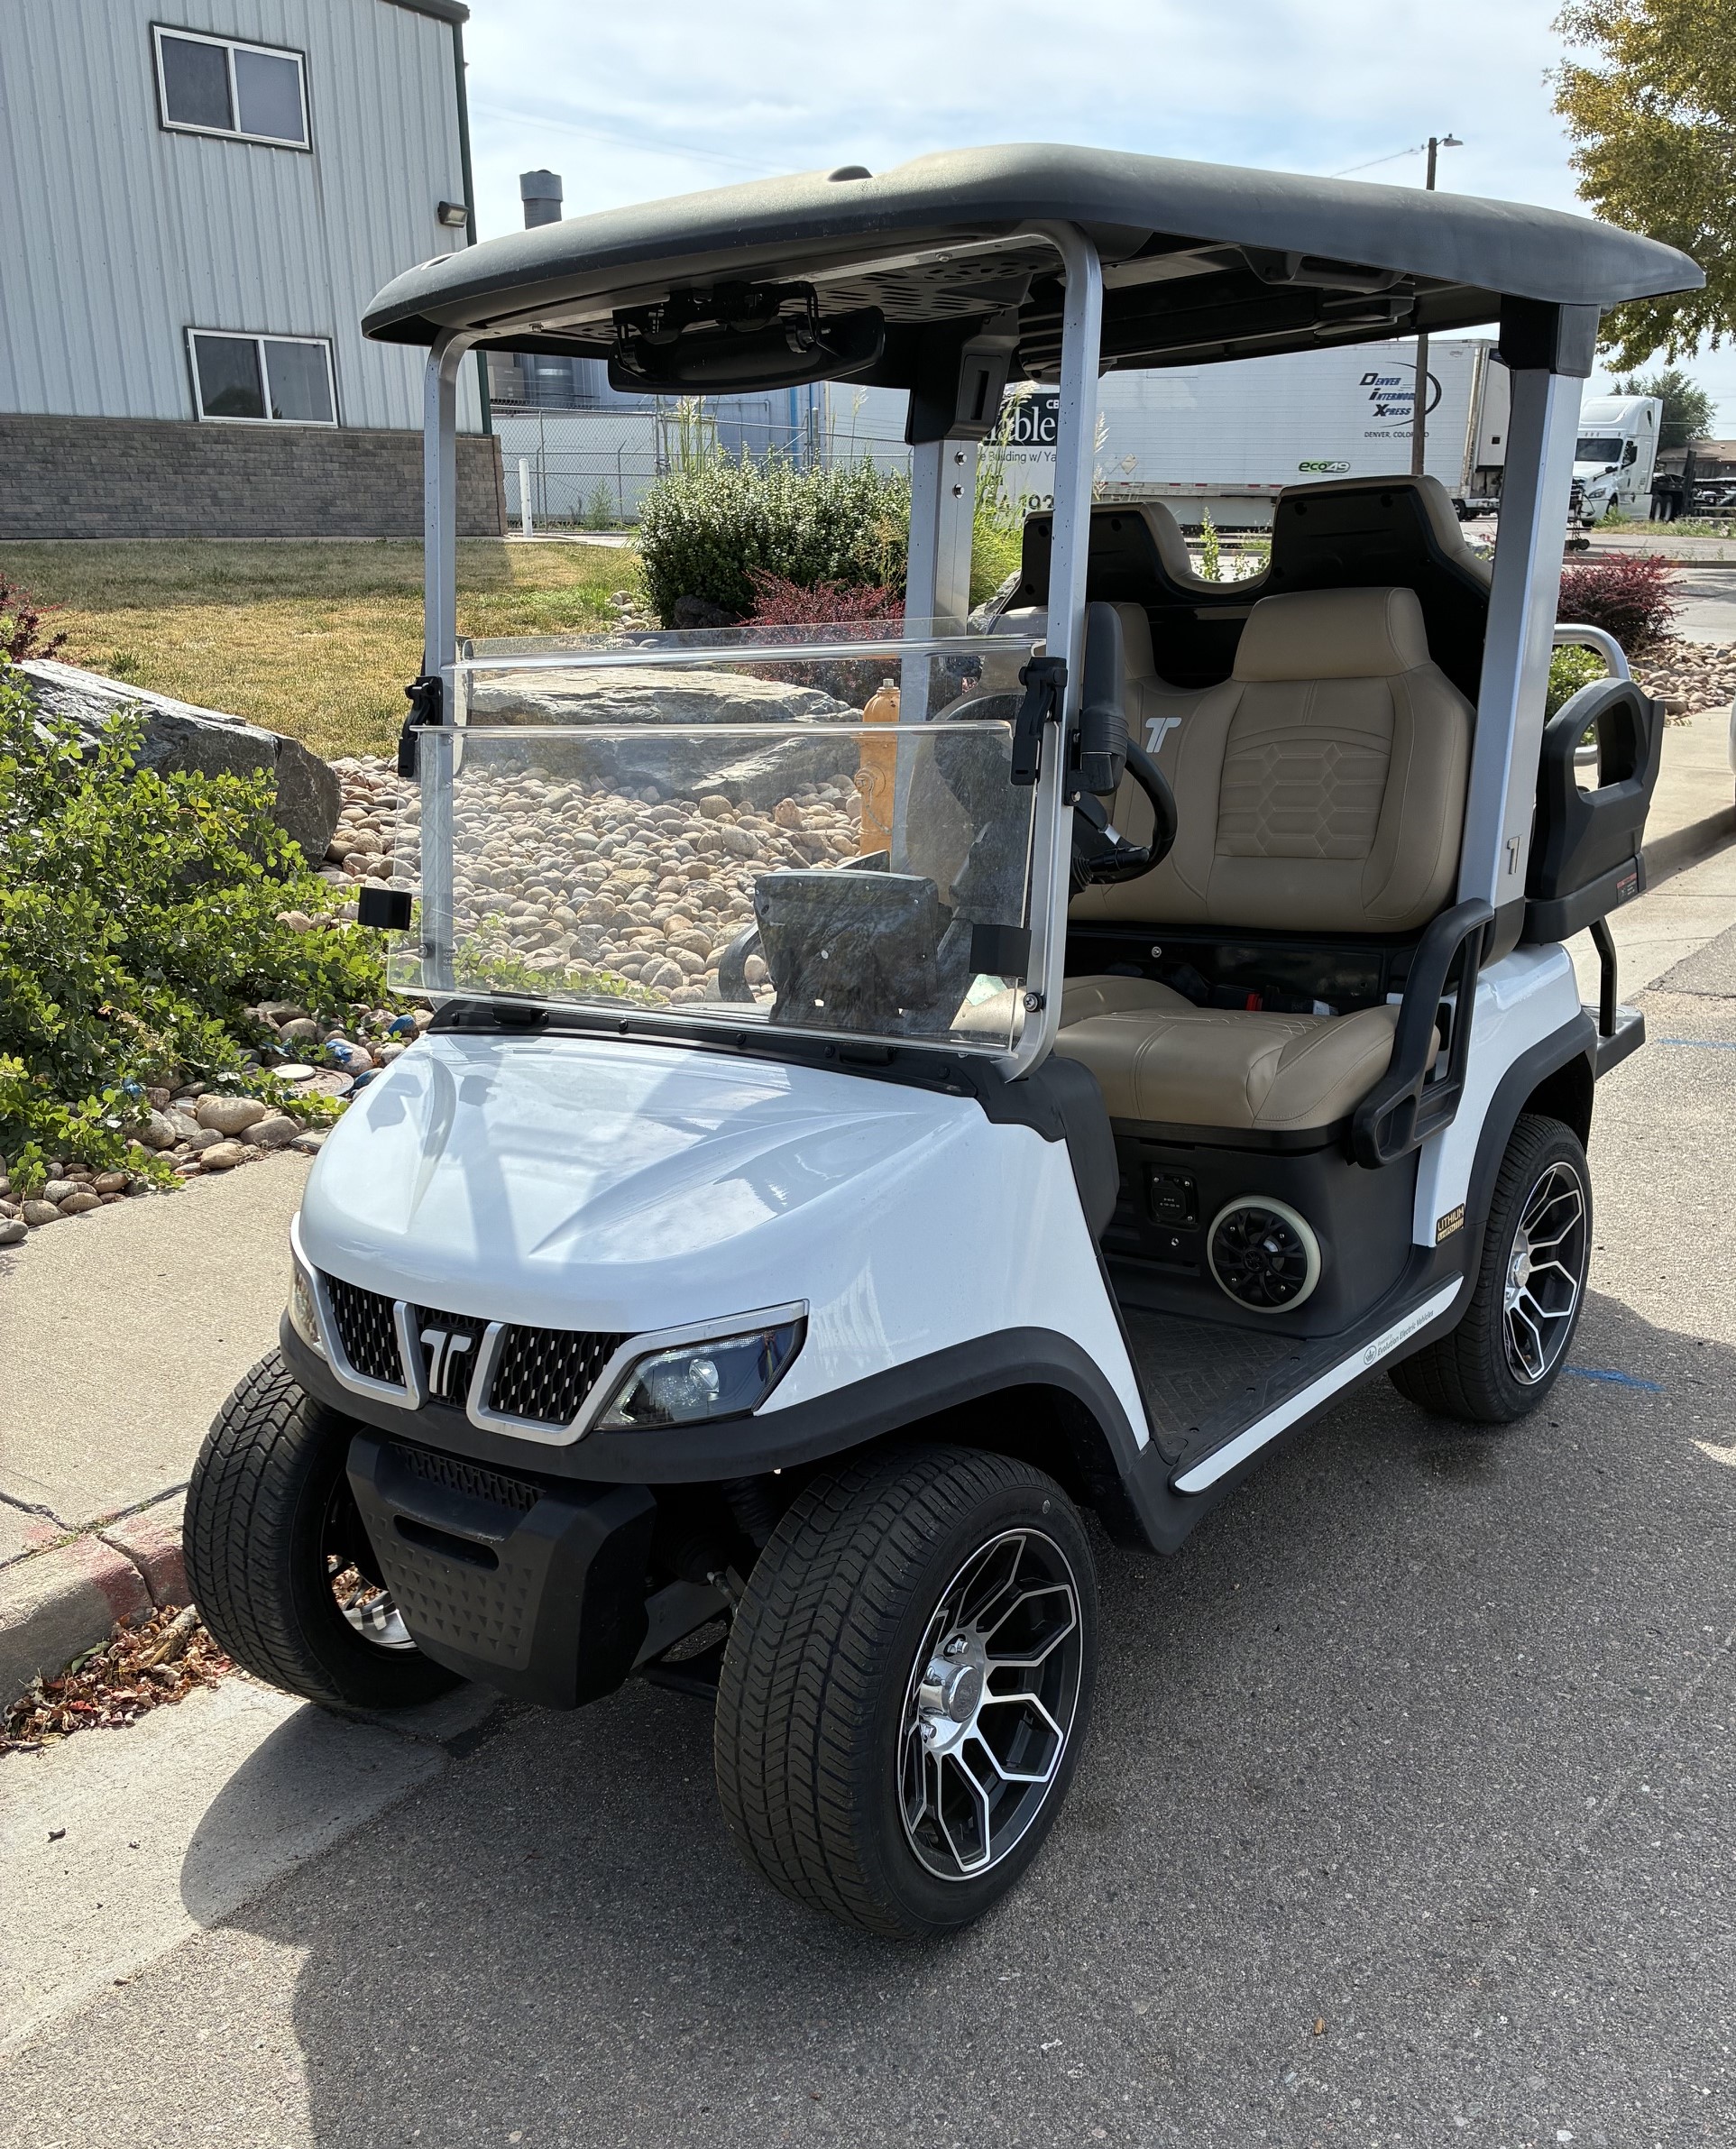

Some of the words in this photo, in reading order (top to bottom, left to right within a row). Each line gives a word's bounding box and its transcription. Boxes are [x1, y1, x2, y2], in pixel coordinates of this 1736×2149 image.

[1046, 399, 1060, 409] CB
[1373, 404, 1411, 417] XPRESS
[1044, 452, 1057, 462] Ya
[1299, 462, 1350, 473] eco49
[1437, 1205, 1465, 1232] LITHIUM
